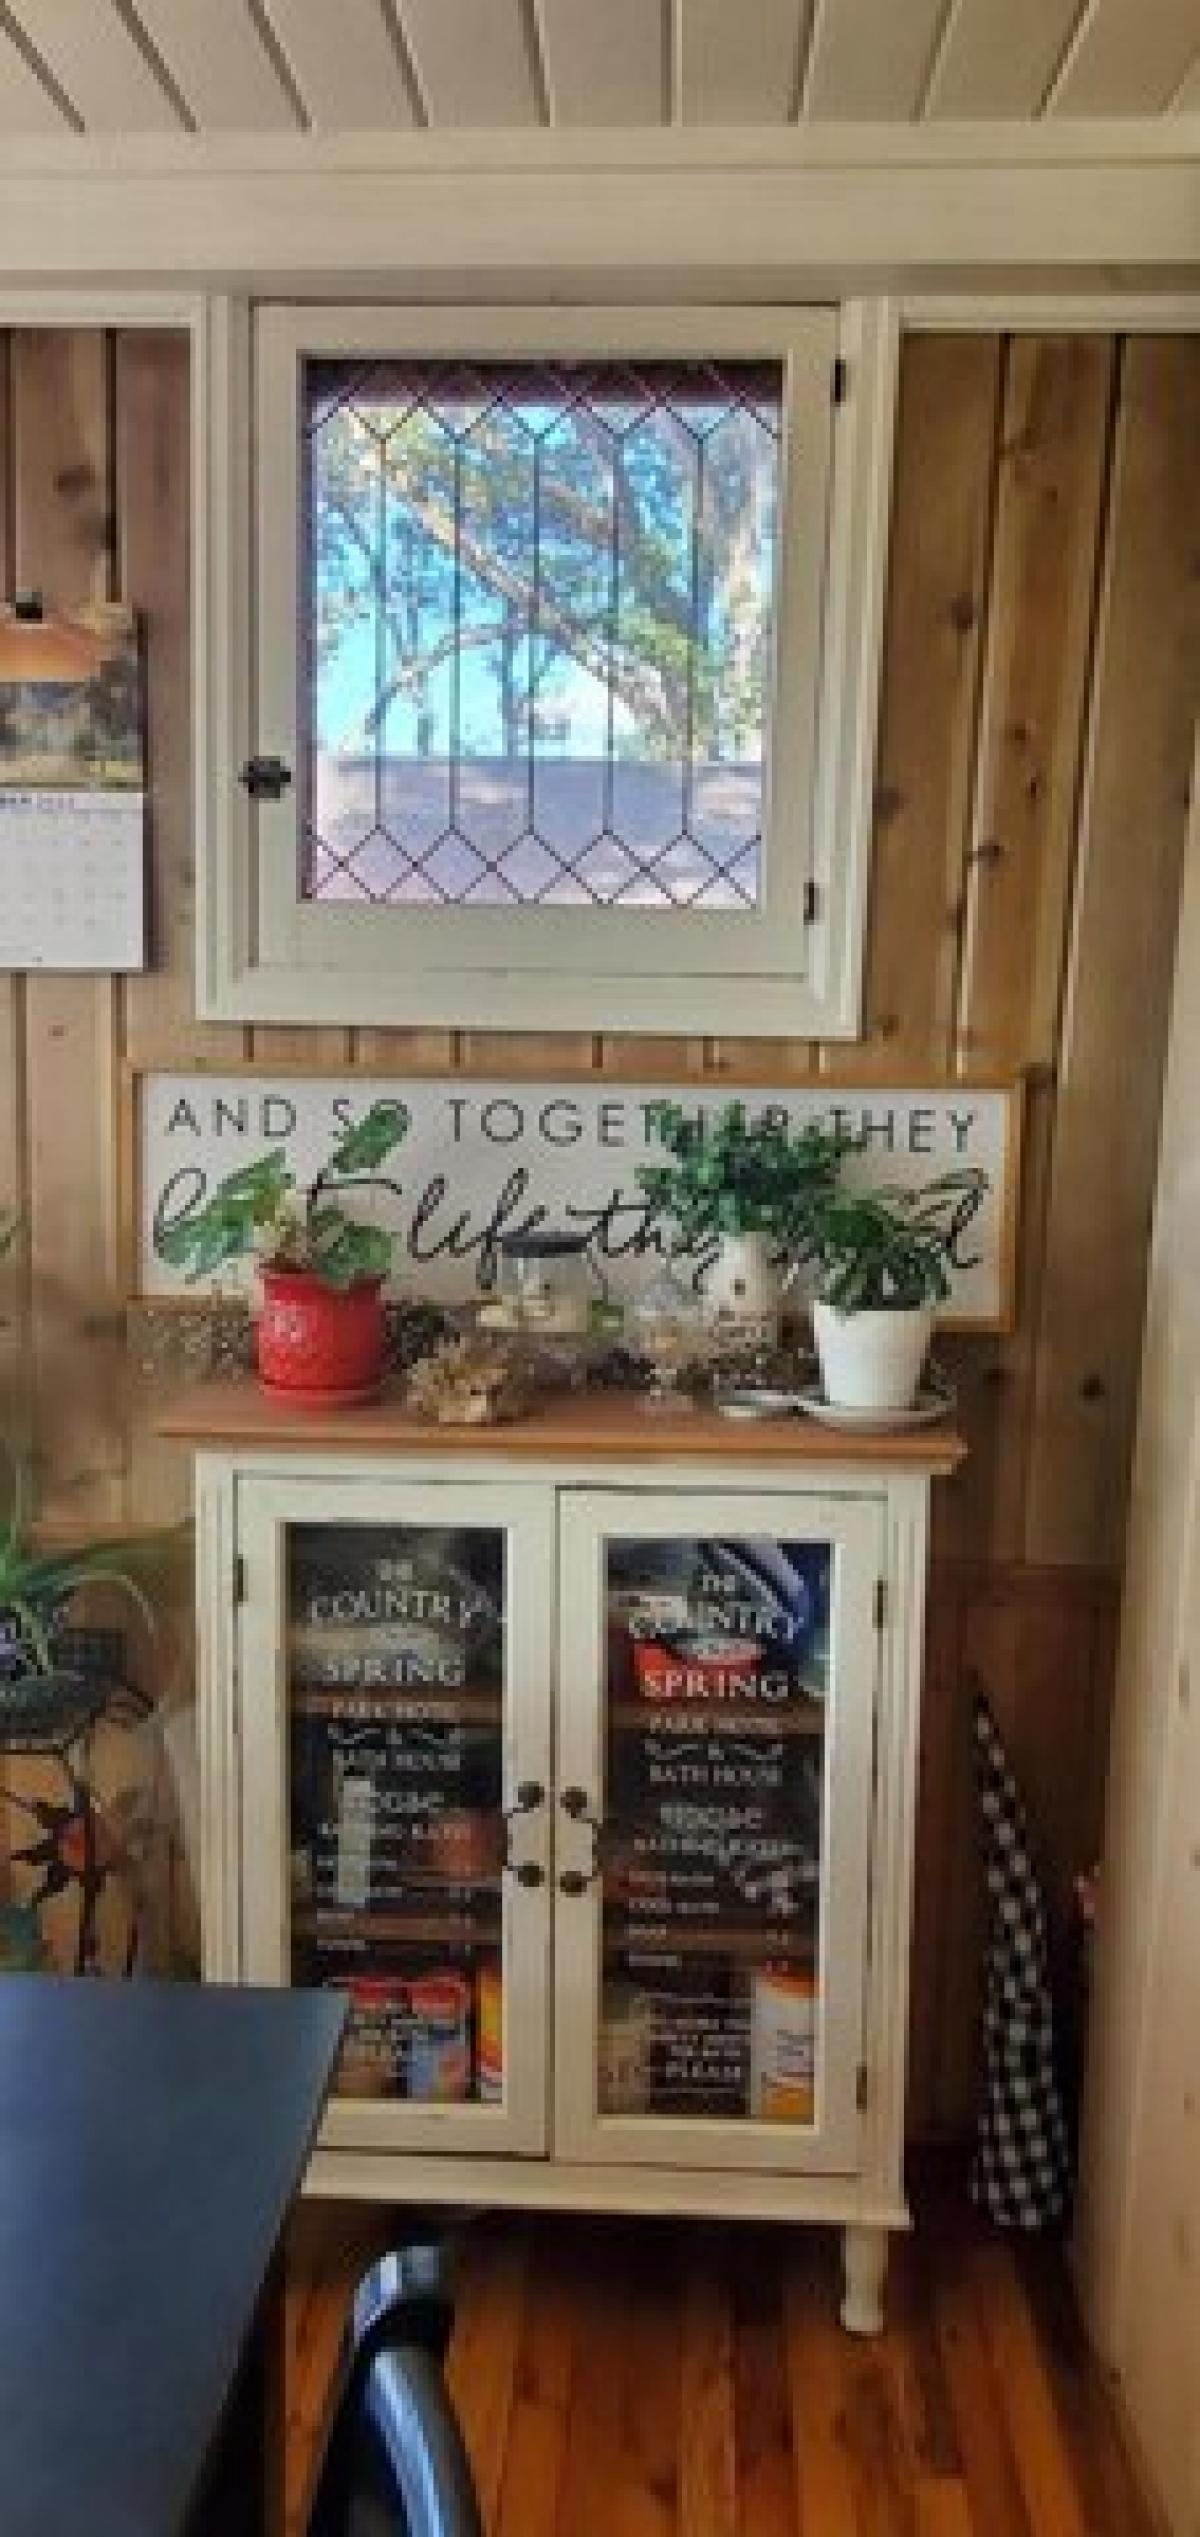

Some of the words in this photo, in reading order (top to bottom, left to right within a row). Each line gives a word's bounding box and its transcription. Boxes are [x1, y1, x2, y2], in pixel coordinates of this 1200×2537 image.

[167, 1097, 298, 1138] AND
[829, 1107, 980, 1153] THEY
[310, 1589, 480, 1629] COUNTRY
[627, 1598, 805, 1644] COUNTRY
[322, 1657, 466, 1687] SPRING
[641, 1669, 790, 1702] SPRING
